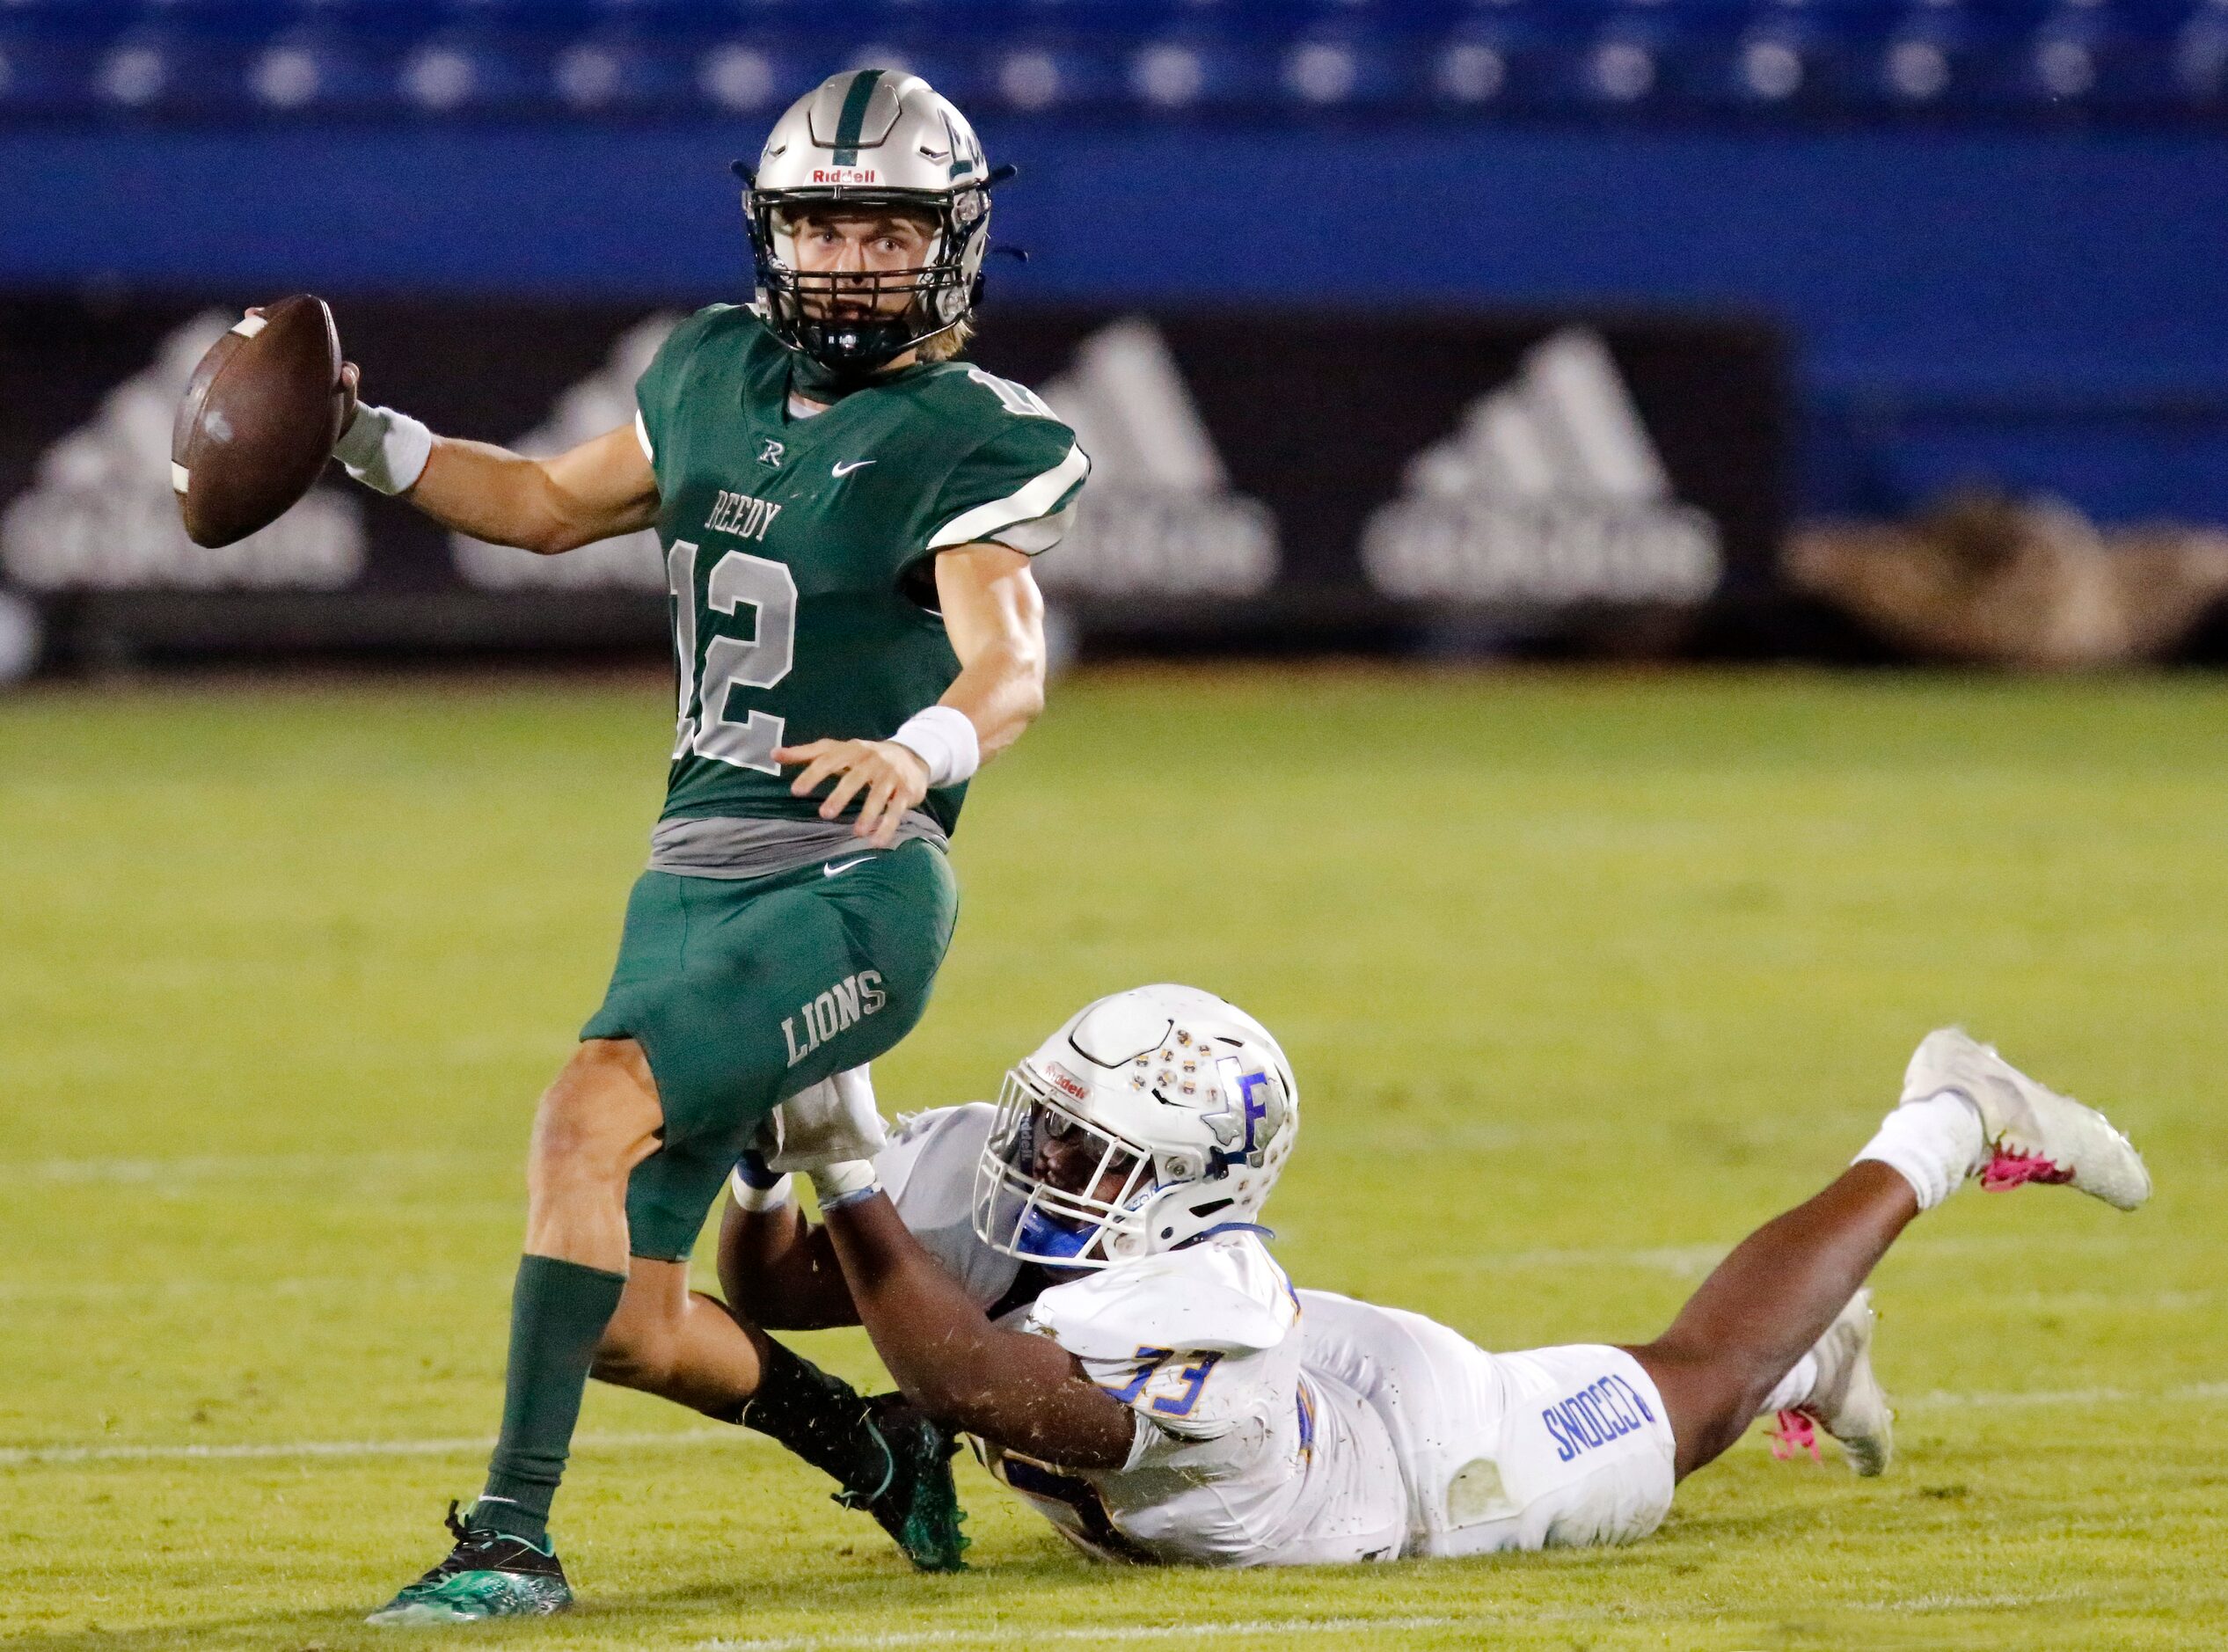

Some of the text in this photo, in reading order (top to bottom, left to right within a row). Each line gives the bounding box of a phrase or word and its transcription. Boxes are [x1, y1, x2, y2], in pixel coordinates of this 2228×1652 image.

[758, 438, 785, 467] R
[705, 489, 782, 543] REEDY
[668, 538, 799, 777] 12
[780, 969, 887, 1069] LIONS
[1235, 1071, 1268, 1154] F
